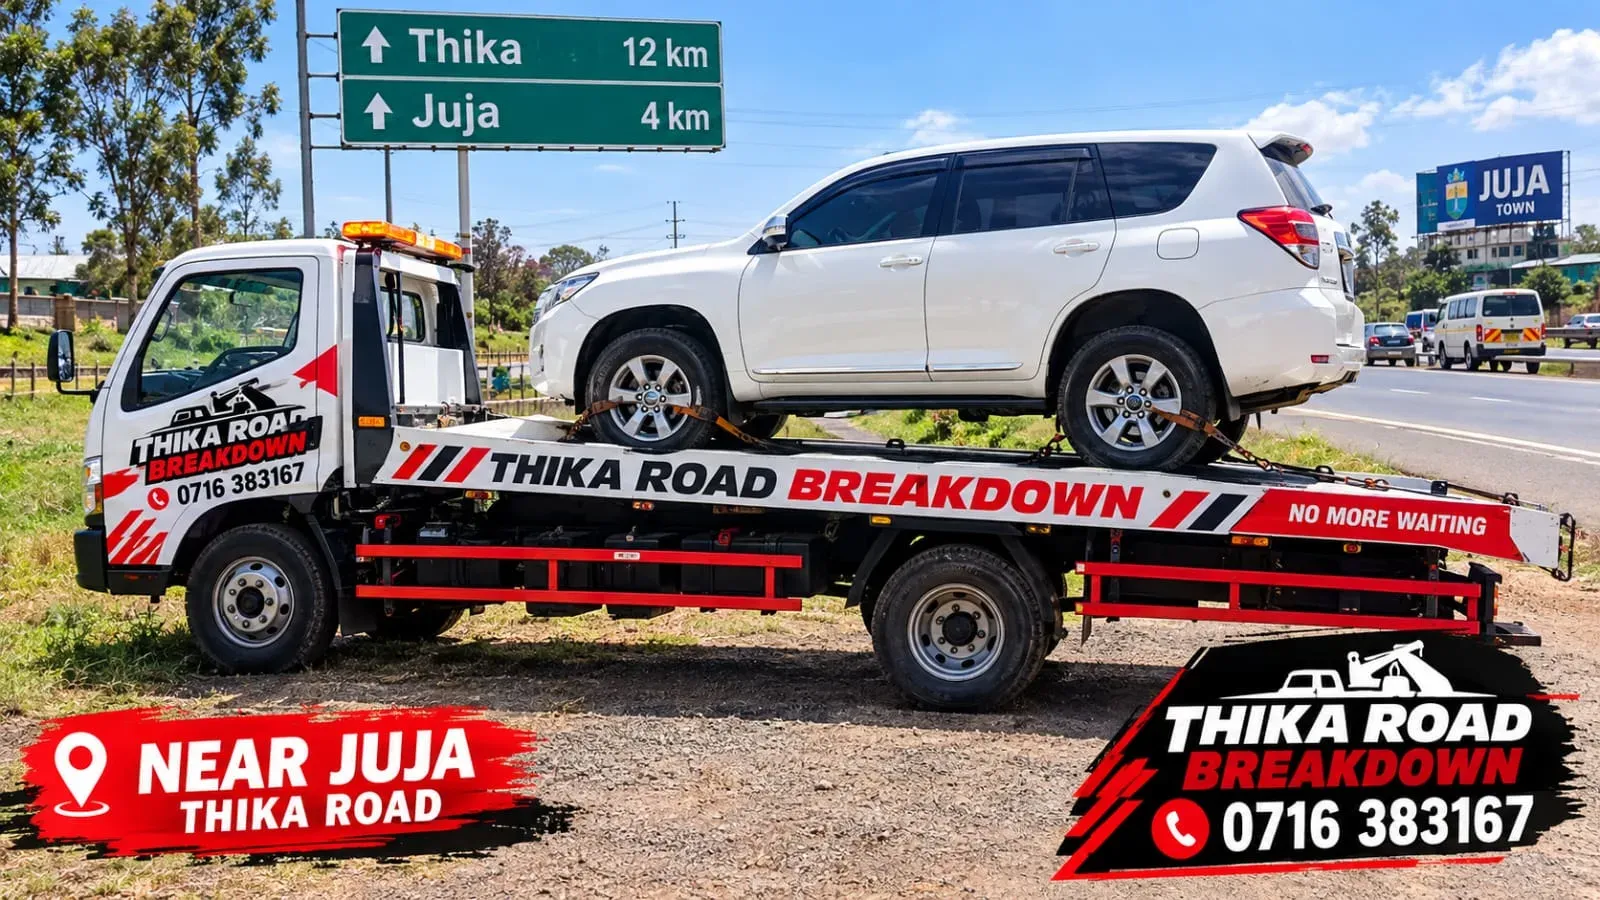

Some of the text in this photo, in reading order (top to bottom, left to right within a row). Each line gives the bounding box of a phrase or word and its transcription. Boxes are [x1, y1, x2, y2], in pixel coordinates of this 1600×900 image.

[409, 28, 522, 65] Thika
[623, 37, 708, 68] 12 km
[412, 92, 500, 137] Juja
[641, 102, 710, 131] 4 km
[1479, 164, 1550, 202] JUJA
[1496, 201, 1535, 217] TOWN
[134, 424, 222, 463] THIKA
[147, 430, 307, 483] BREAKDOWN
[177, 462, 305, 505] 0716 383167
[490, 453, 1144, 519] THIKA ROAD BREAKDOWN
[1288, 503, 1487, 536] NO MORE WAITING
